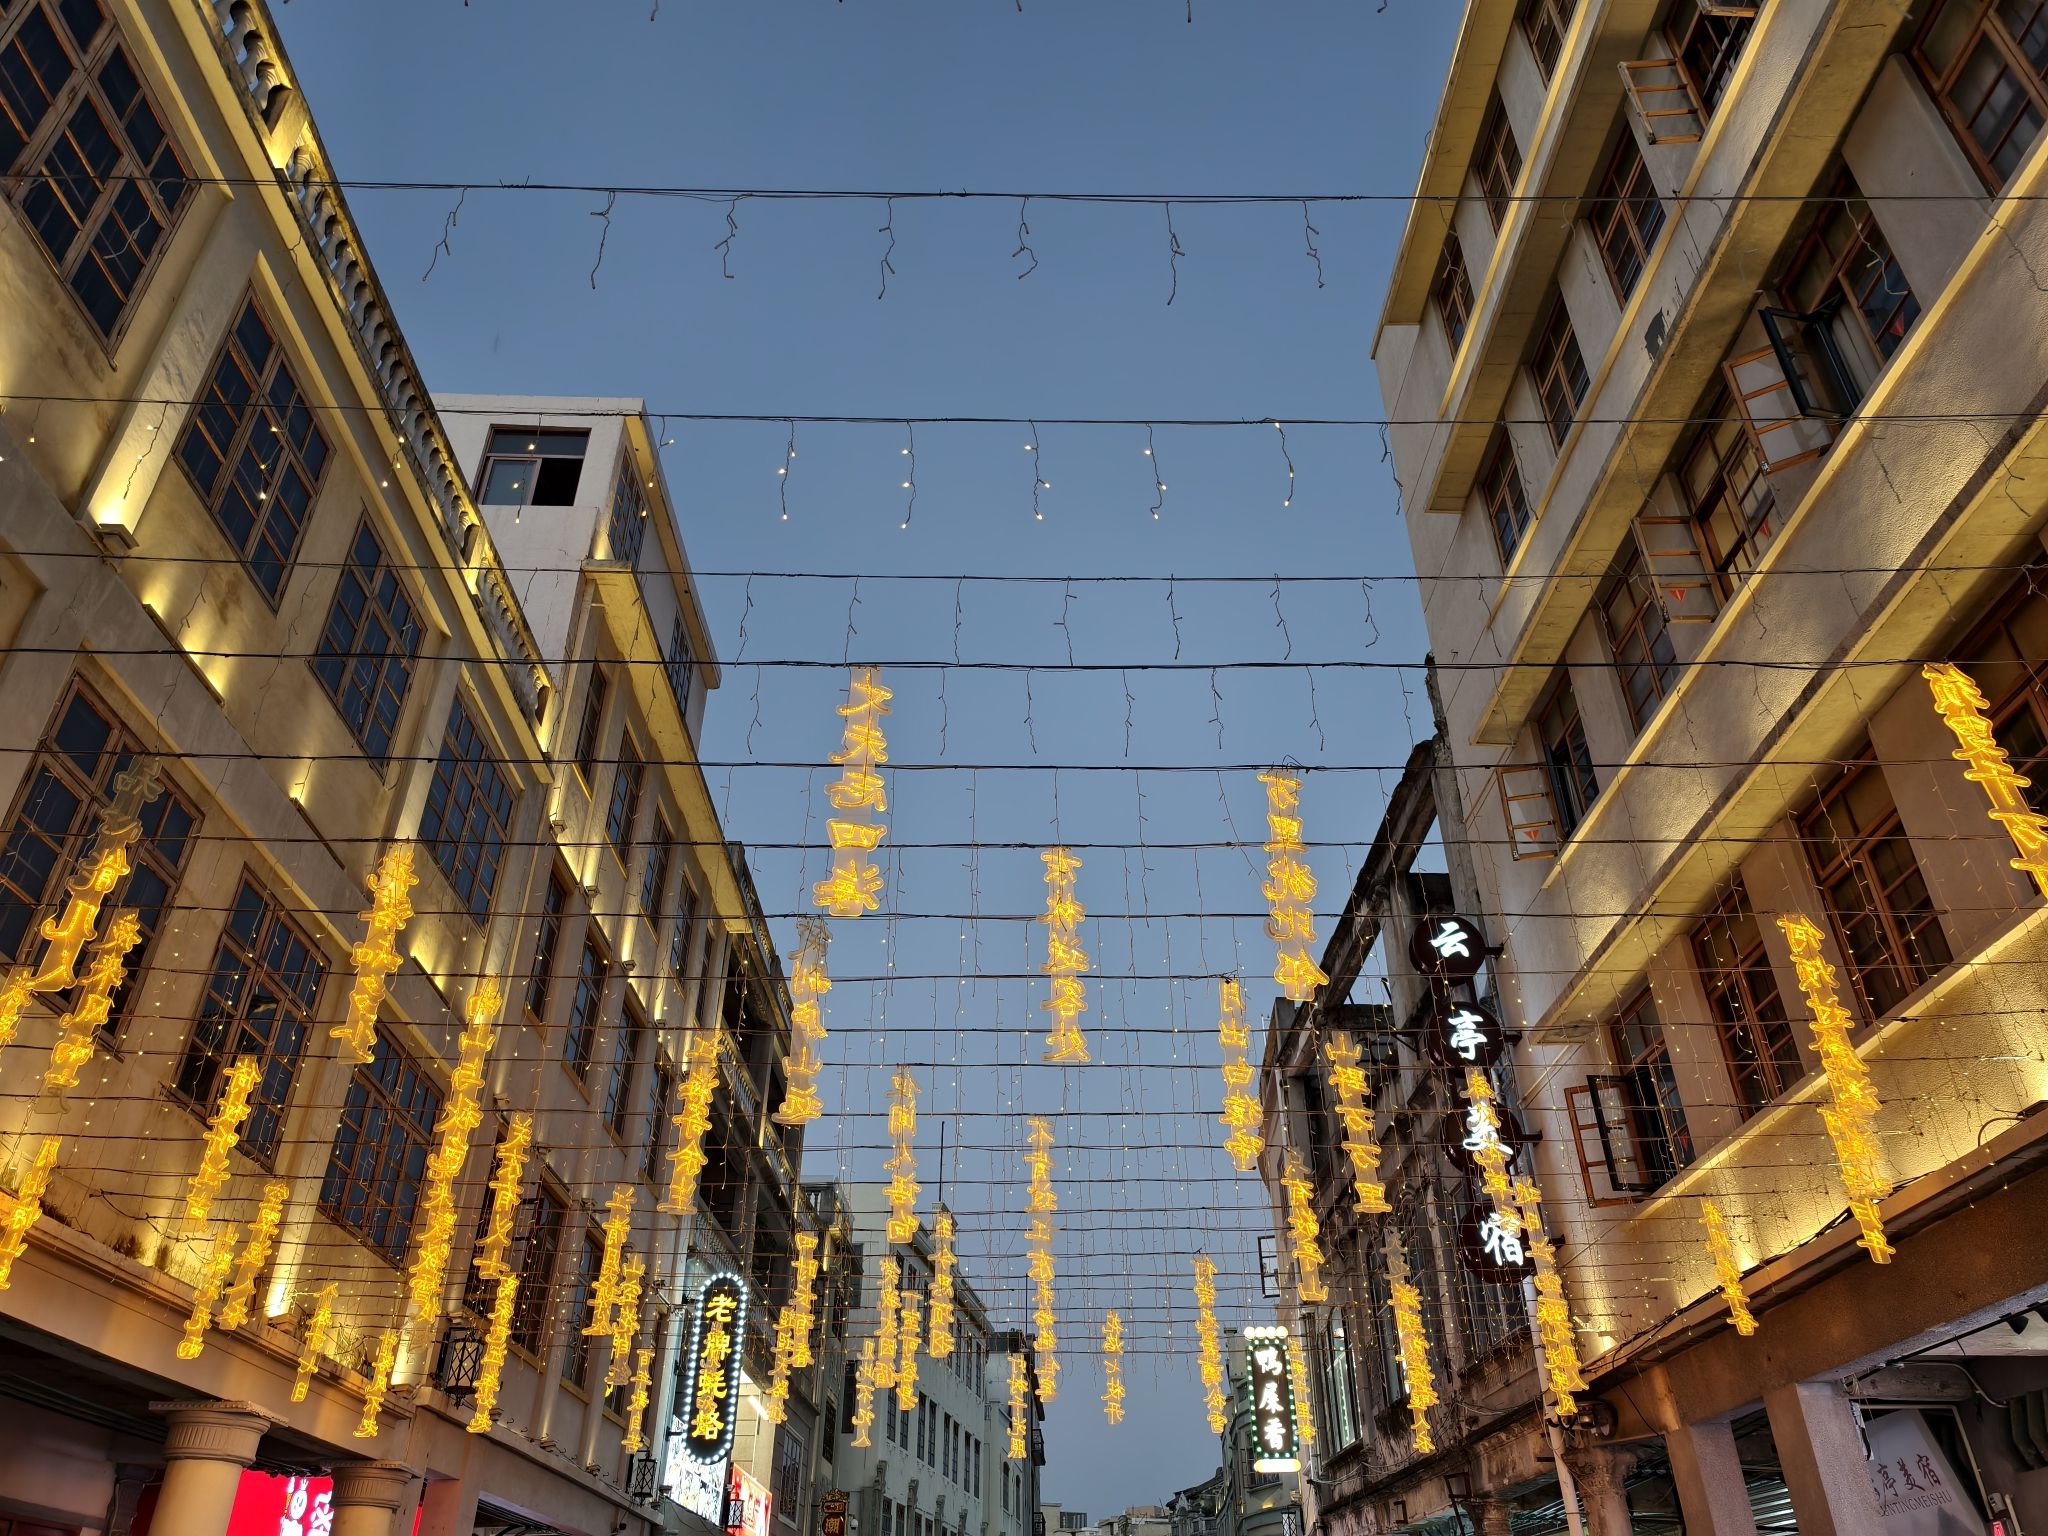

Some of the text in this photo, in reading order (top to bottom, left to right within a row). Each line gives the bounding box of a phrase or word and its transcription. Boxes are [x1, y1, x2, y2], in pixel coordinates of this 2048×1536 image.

[1430, 921, 1524, 1267] 云亭美宿
[692, 1294, 738, 1441] 老牌蚝烙
[1255, 1347, 1286, 1450] 鸭屎香
[1871, 1453, 1942, 1500] 亭美宿
